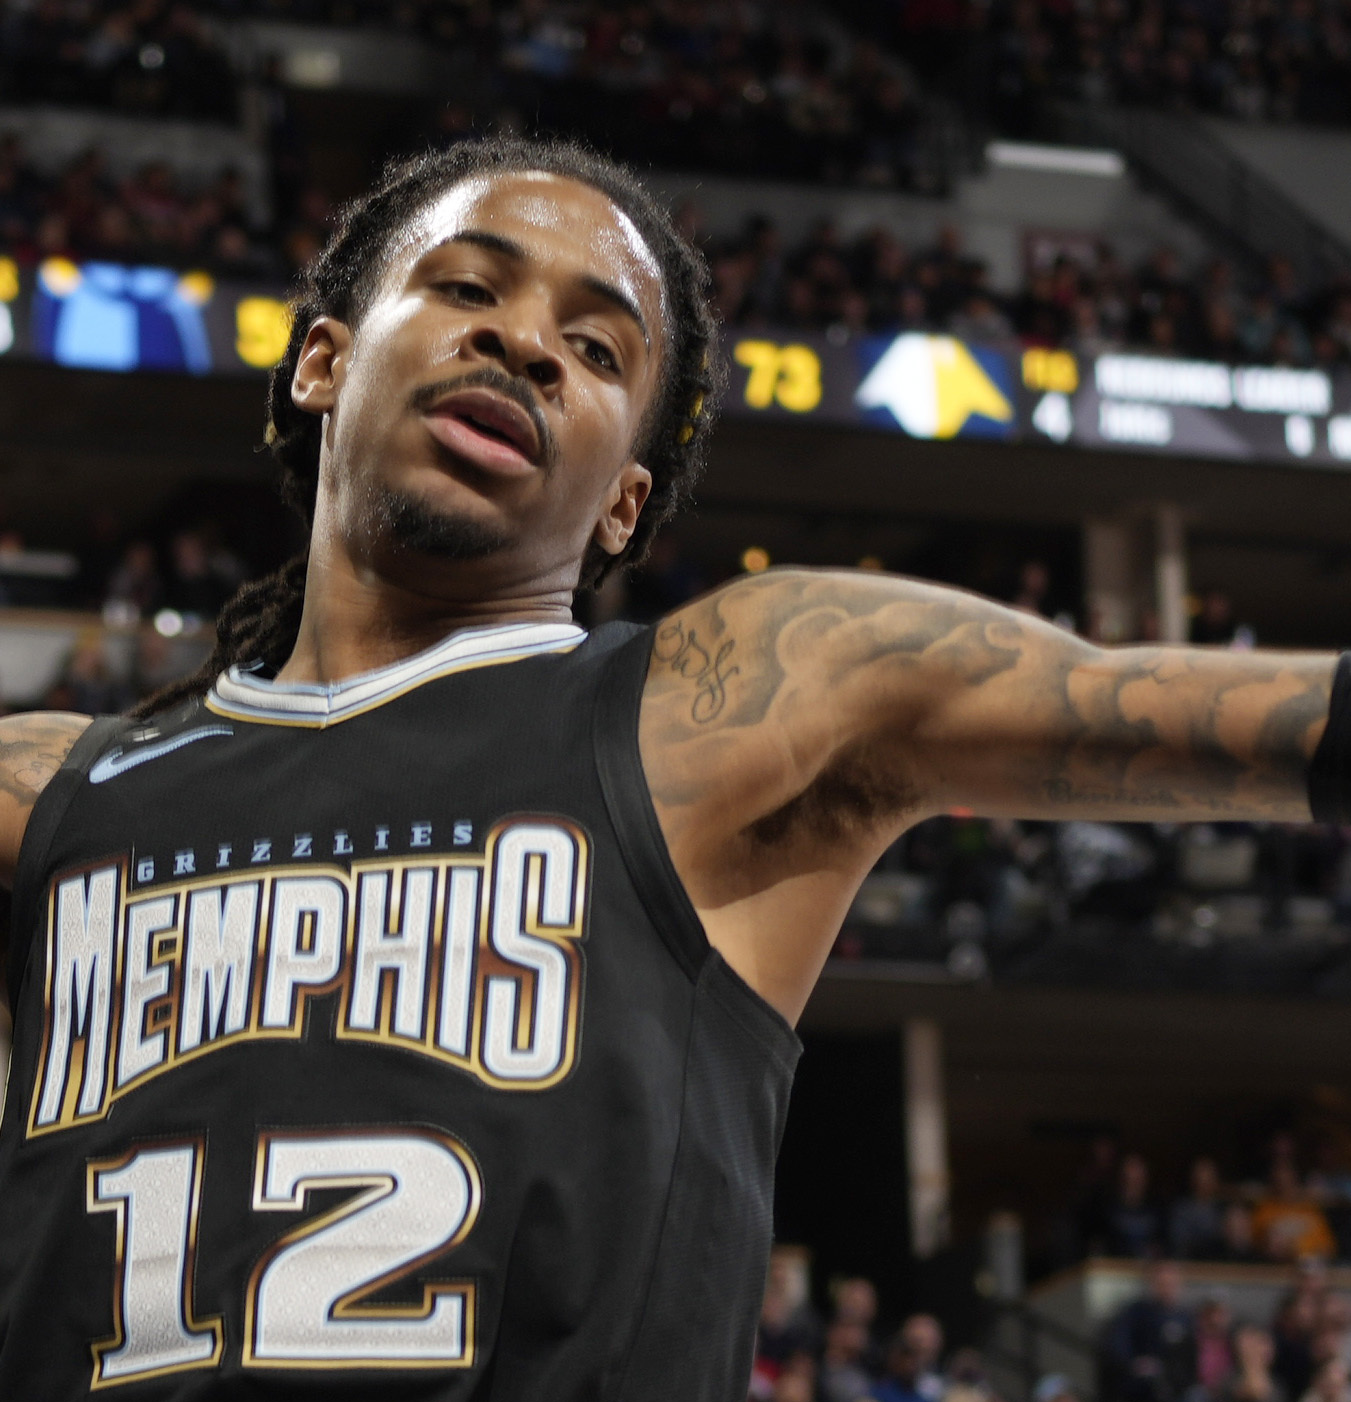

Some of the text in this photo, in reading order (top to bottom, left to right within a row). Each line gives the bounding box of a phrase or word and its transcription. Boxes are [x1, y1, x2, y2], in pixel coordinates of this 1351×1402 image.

[735, 340, 821, 412] 73
[136, 819, 474, 883] GRIZZLIES
[27, 813, 589, 1139] MEMPHIS
[86, 1126, 482, 1391] 12
